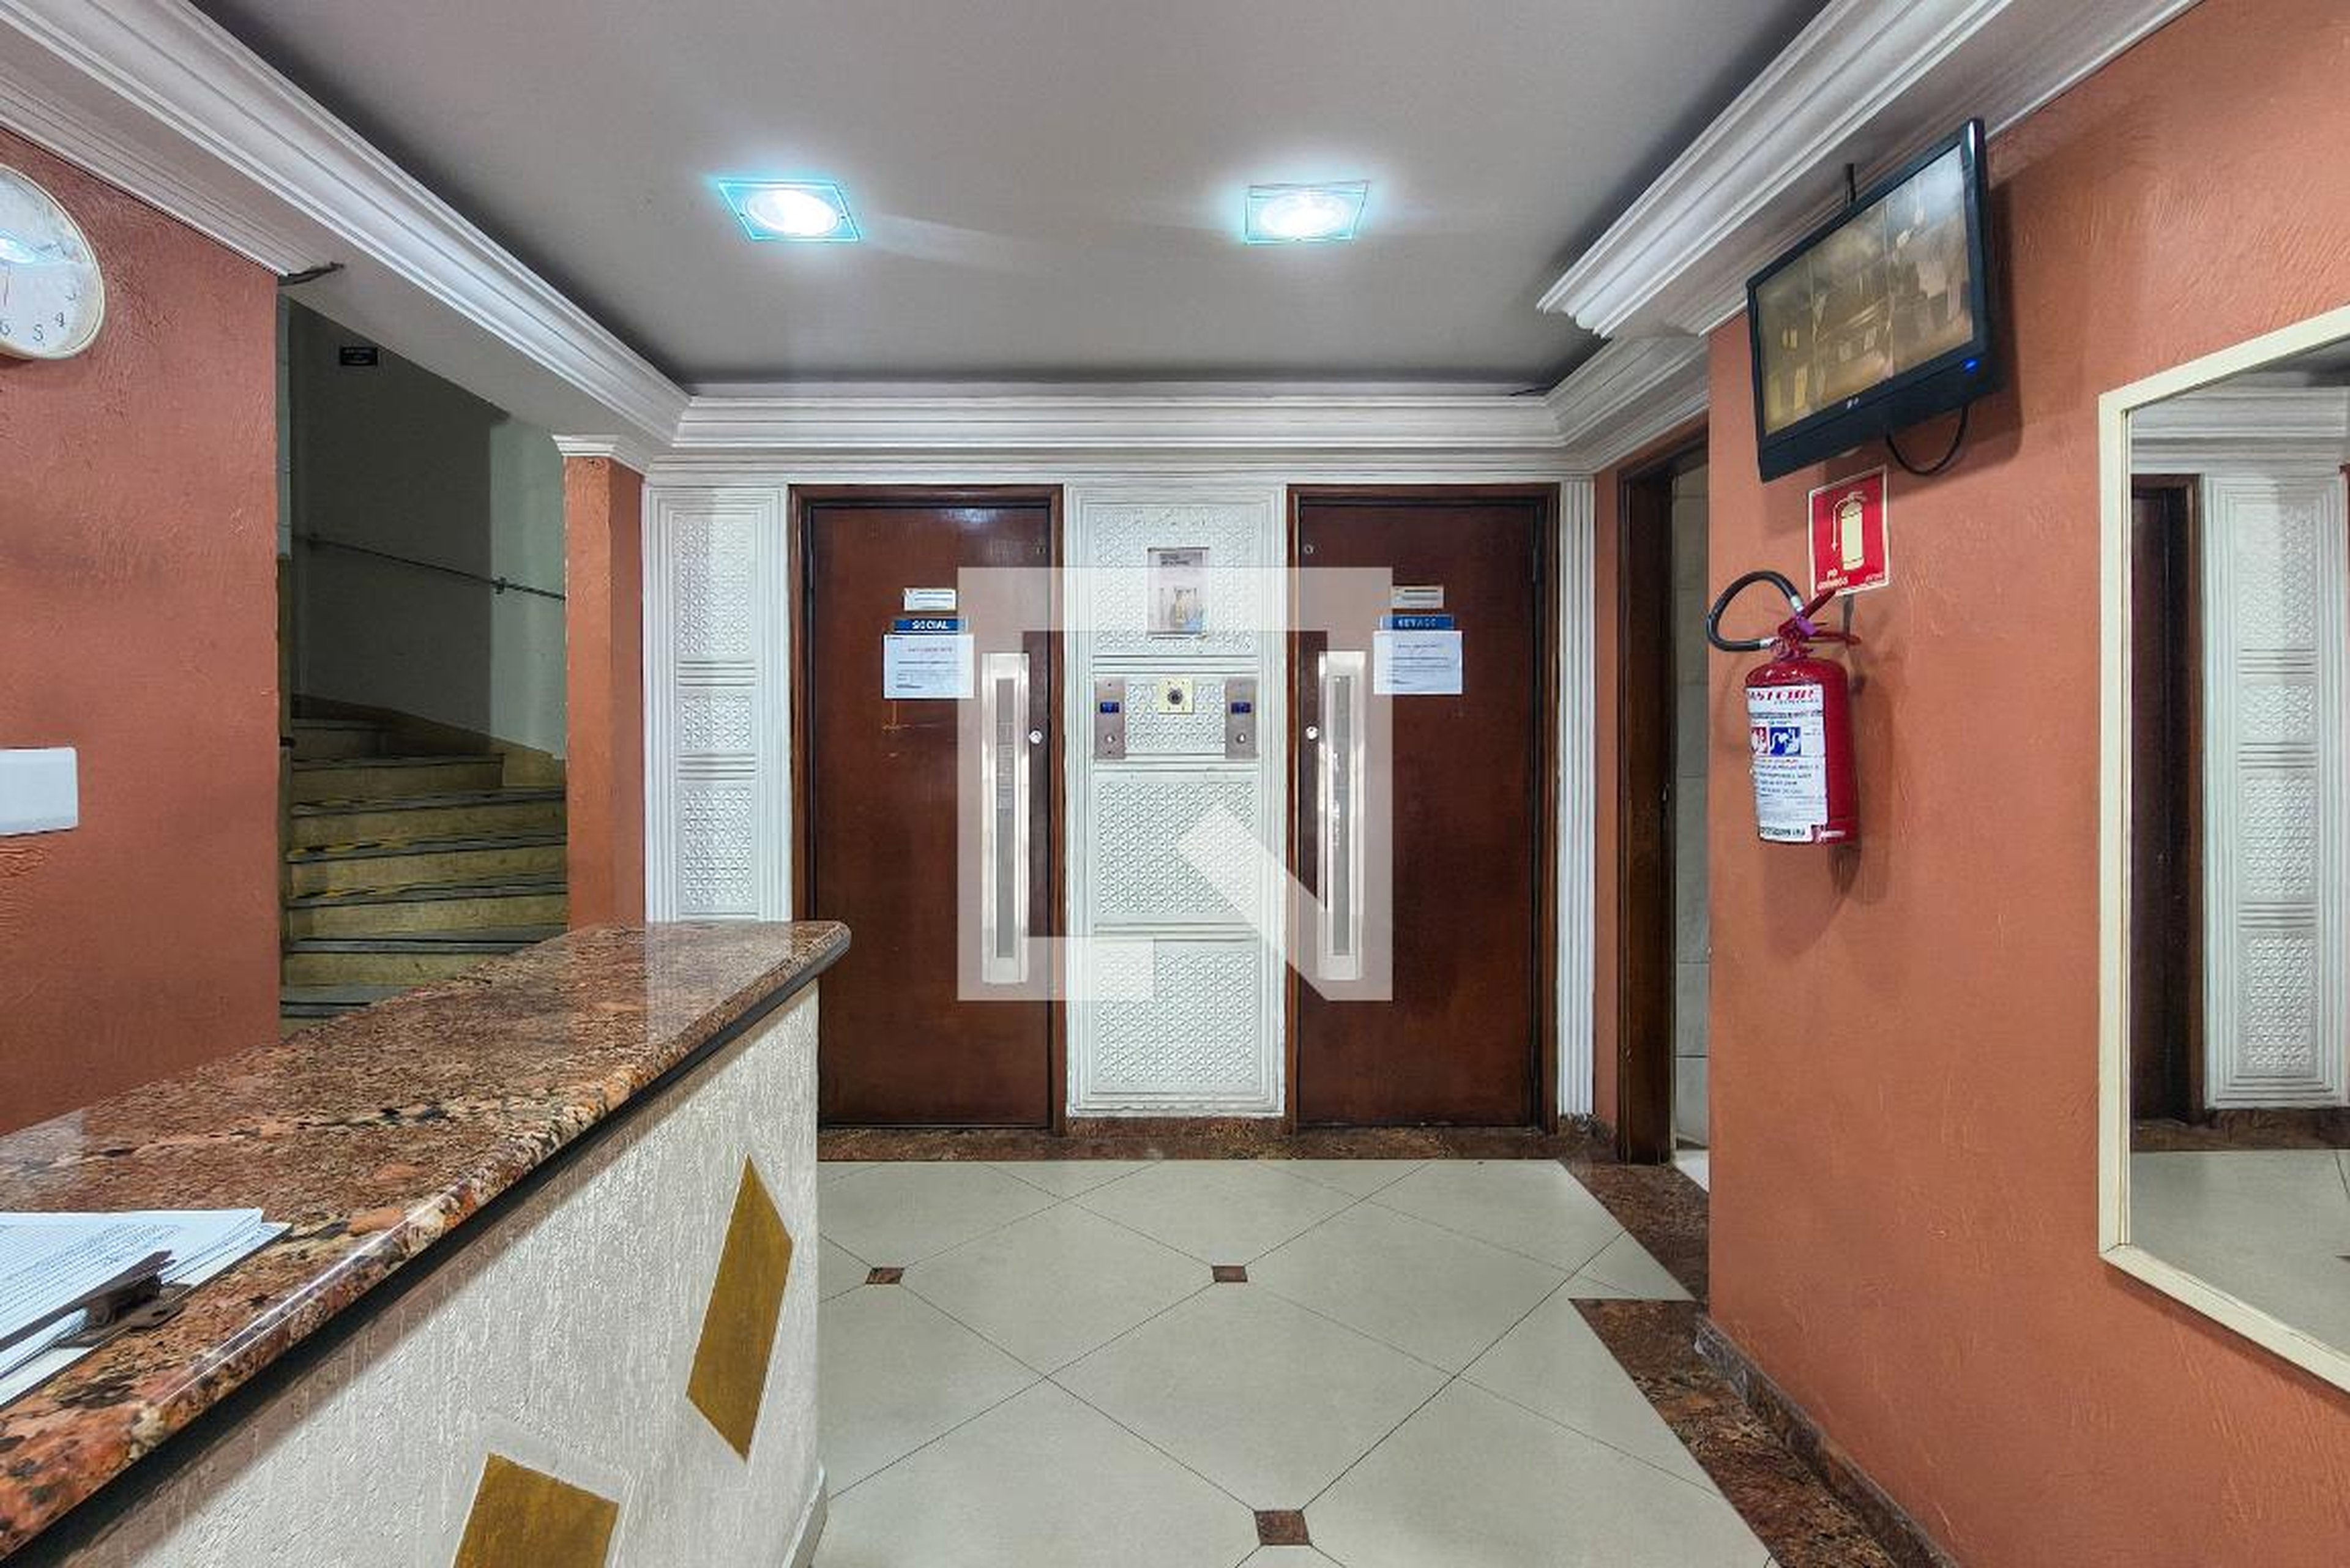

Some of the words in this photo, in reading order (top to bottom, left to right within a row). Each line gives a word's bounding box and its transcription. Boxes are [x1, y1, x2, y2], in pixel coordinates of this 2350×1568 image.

[55, 312, 64, 327] 4
[32, 324, 43, 341] 5
[912, 620, 949, 629] SOCIAL
